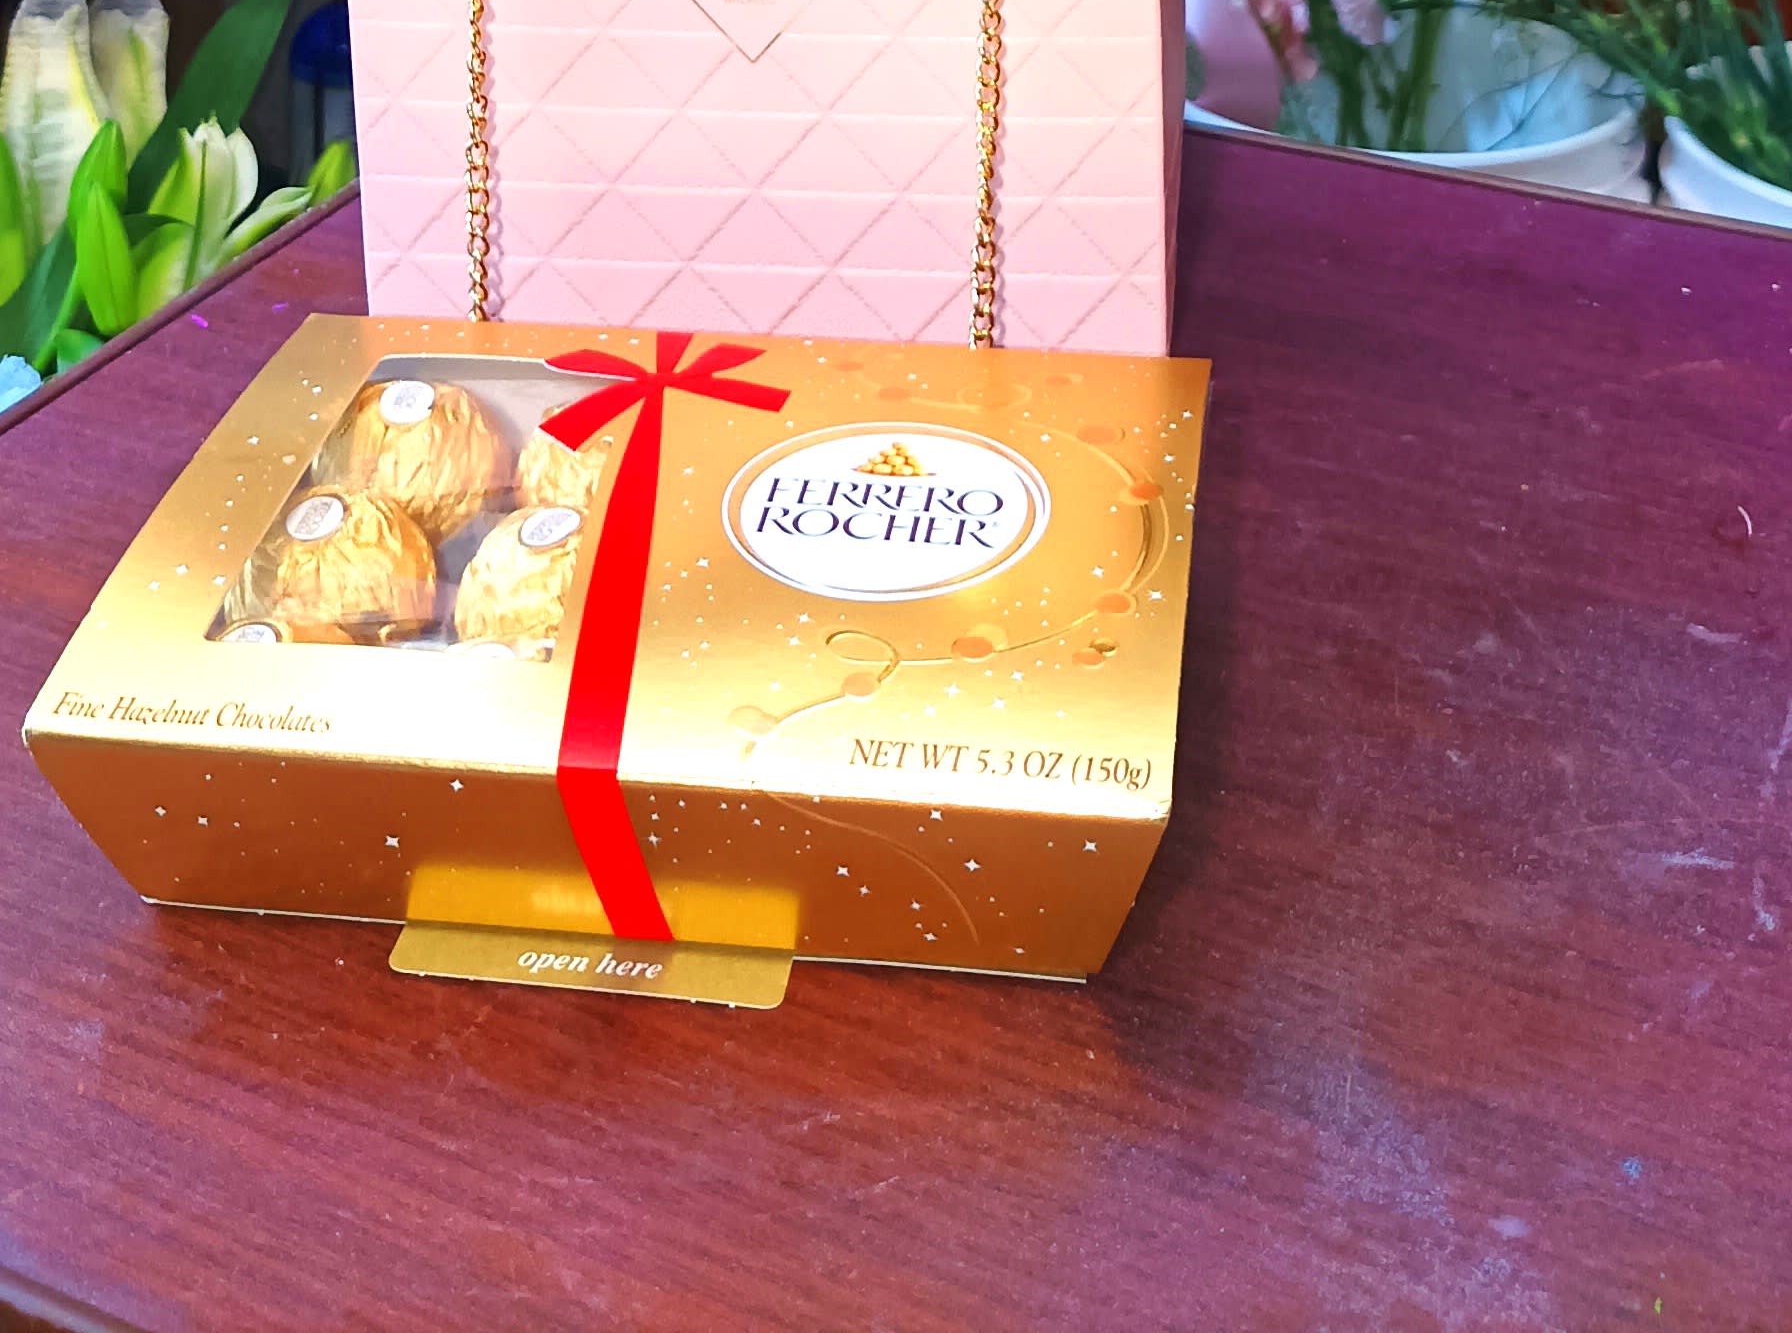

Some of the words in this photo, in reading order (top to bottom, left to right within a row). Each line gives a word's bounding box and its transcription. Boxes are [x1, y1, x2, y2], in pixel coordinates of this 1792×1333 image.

[765, 476, 1005, 517] FERRERO
[52, 690, 105, 719] Fine
[108, 695, 211, 726] Hazelnut
[215, 701, 334, 734] Chocolates
[849, 737, 914, 769] NET
[920, 742, 970, 773] WT
[974, 748, 1014, 778] 5.3
[1022, 749, 1066, 782] OZ
[1070, 753, 1153, 792] (150g)
[518, 951, 590, 974] open
[595, 952, 664, 980] here
